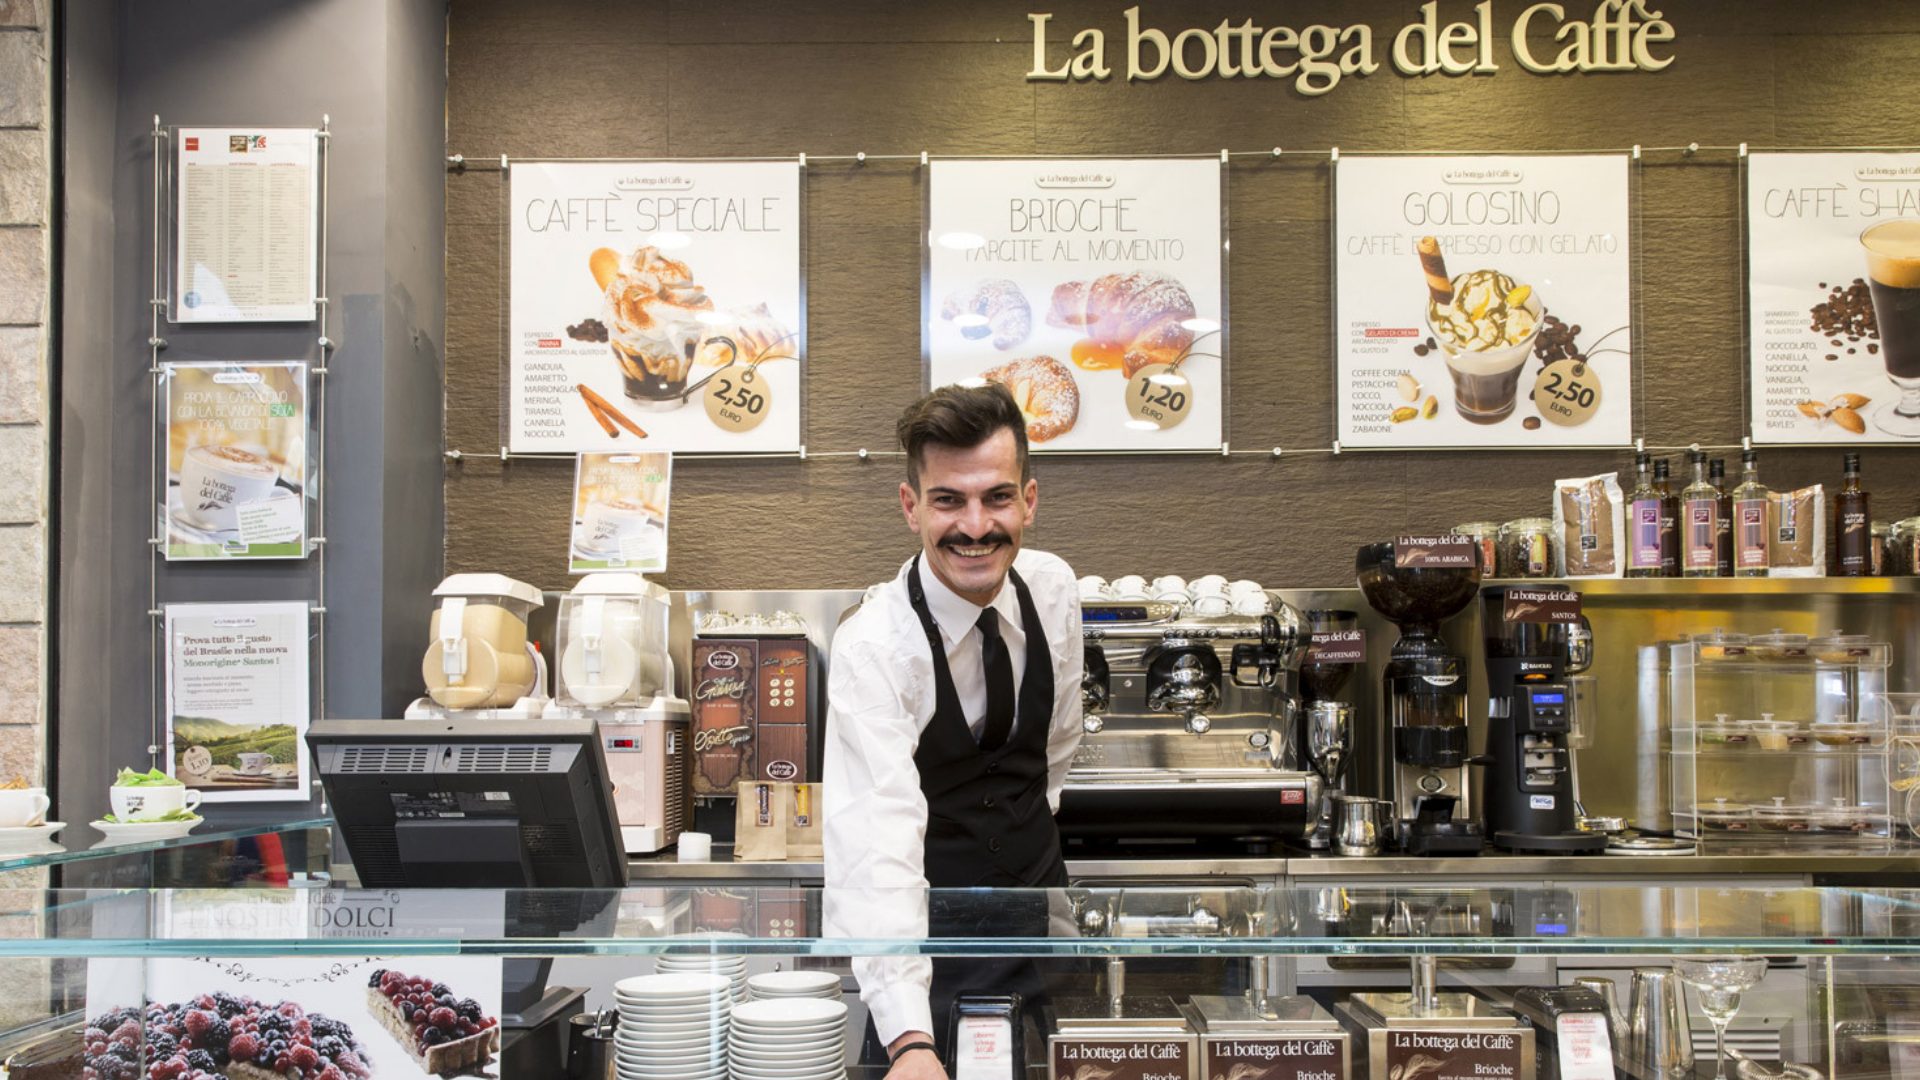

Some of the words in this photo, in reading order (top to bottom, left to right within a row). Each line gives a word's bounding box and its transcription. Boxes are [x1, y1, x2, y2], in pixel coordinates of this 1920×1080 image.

[1026, 13, 1110, 80] La
[1123, 5, 1379, 96] bottega
[1392, 0, 1499, 75] del
[1511, 0, 1676, 73] Caffè
[1403, 190, 1561, 226] GOLOSINO
[1764, 183, 1848, 218] CAFFÈ
[525, 191, 624, 232] CAFFÈ
[636, 197, 781, 232] SPECIALE
[1009, 198, 1138, 233] BRIOCHE
[1052, 239, 1079, 261] AL
[1088, 238, 1184, 261] MOMENTO
[1347, 233, 1405, 255] CAFFÈ
[1411, 234, 1501, 254] EPRESSO
[1509, 233, 1545, 254] CON
[1550, 233, 1618, 254] GELATO
[1352, 369, 1380, 377] COFFEE
[713, 378, 764, 414] 2,50
[1140, 377, 1186, 412] 1,20
[1543, 372, 1595, 408] 2,50
[720, 408, 742, 422] EURO
[1141, 406, 1163, 421] EURO
[1550, 402, 1572, 417] EURO
[1766, 421, 1794, 429] BAYLES
[1400, 536, 1408, 545] La
[1410, 535, 1437, 547] bottega
[1438, 535, 1450, 545] del
[1509, 590, 1518, 599] La
[1520, 590, 1546, 603] bottega
[1547, 591, 1559, 600] del
[183, 635, 210, 645] Prova
[212, 635, 235, 644] tutto
[1331, 632, 1342, 640] del
[183, 647, 197, 656] del
[200, 646, 232, 655] Brasile
[234, 645, 256, 654] nella
[259, 646, 288, 654] nuova
[1314, 651, 1361, 659] DECAFFEINATO
[314, 906, 394, 928] DOLCI
[1215, 1042, 1231, 1057] La
[1234, 1042, 1280, 1060] bottega
[1282, 1041, 1302, 1055] del
[1304, 1040, 1335, 1055] Caffè
[1395, 1033, 1410, 1048] La
[1413, 1033, 1459, 1052] bottega
[1461, 1034, 1480, 1049] del
[1483, 1034, 1513, 1049] Caffè
[1062, 1044, 1078, 1059] La
[1080, 1043, 1126, 1063] bottega
[1129, 1043, 1148, 1058] del
[1150, 1043, 1181, 1059] Caffè
[1142, 1072, 1181, 1080] Brioche
[1297, 1070, 1336, 1080] Brioche
[1474, 1063, 1513, 1075] Brioche
